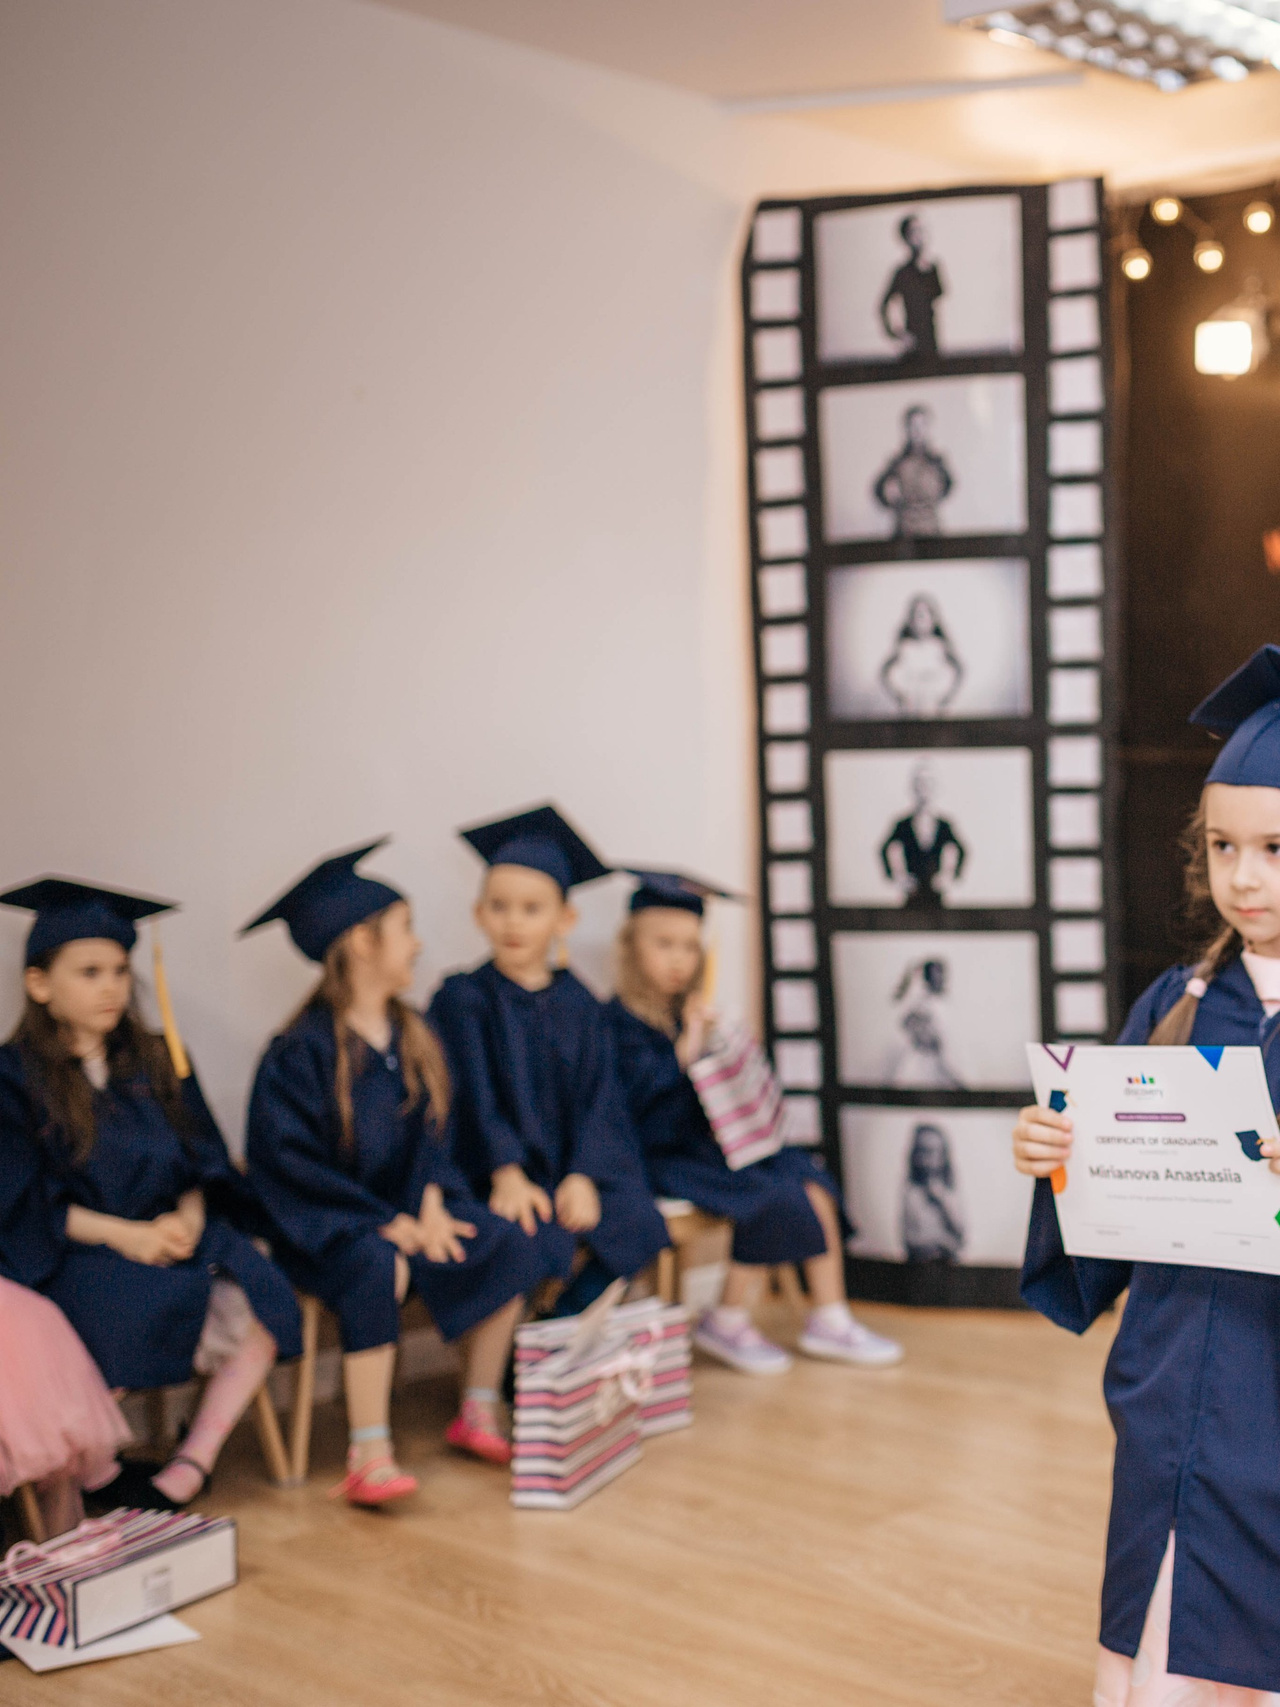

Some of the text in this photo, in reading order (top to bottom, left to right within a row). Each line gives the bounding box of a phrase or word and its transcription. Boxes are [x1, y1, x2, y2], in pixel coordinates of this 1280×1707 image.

[1096, 1136, 1218, 1147] CERTIFICATE OF GRADUATION
[1089, 1164, 1242, 1184] Mirianova Anastasiia
